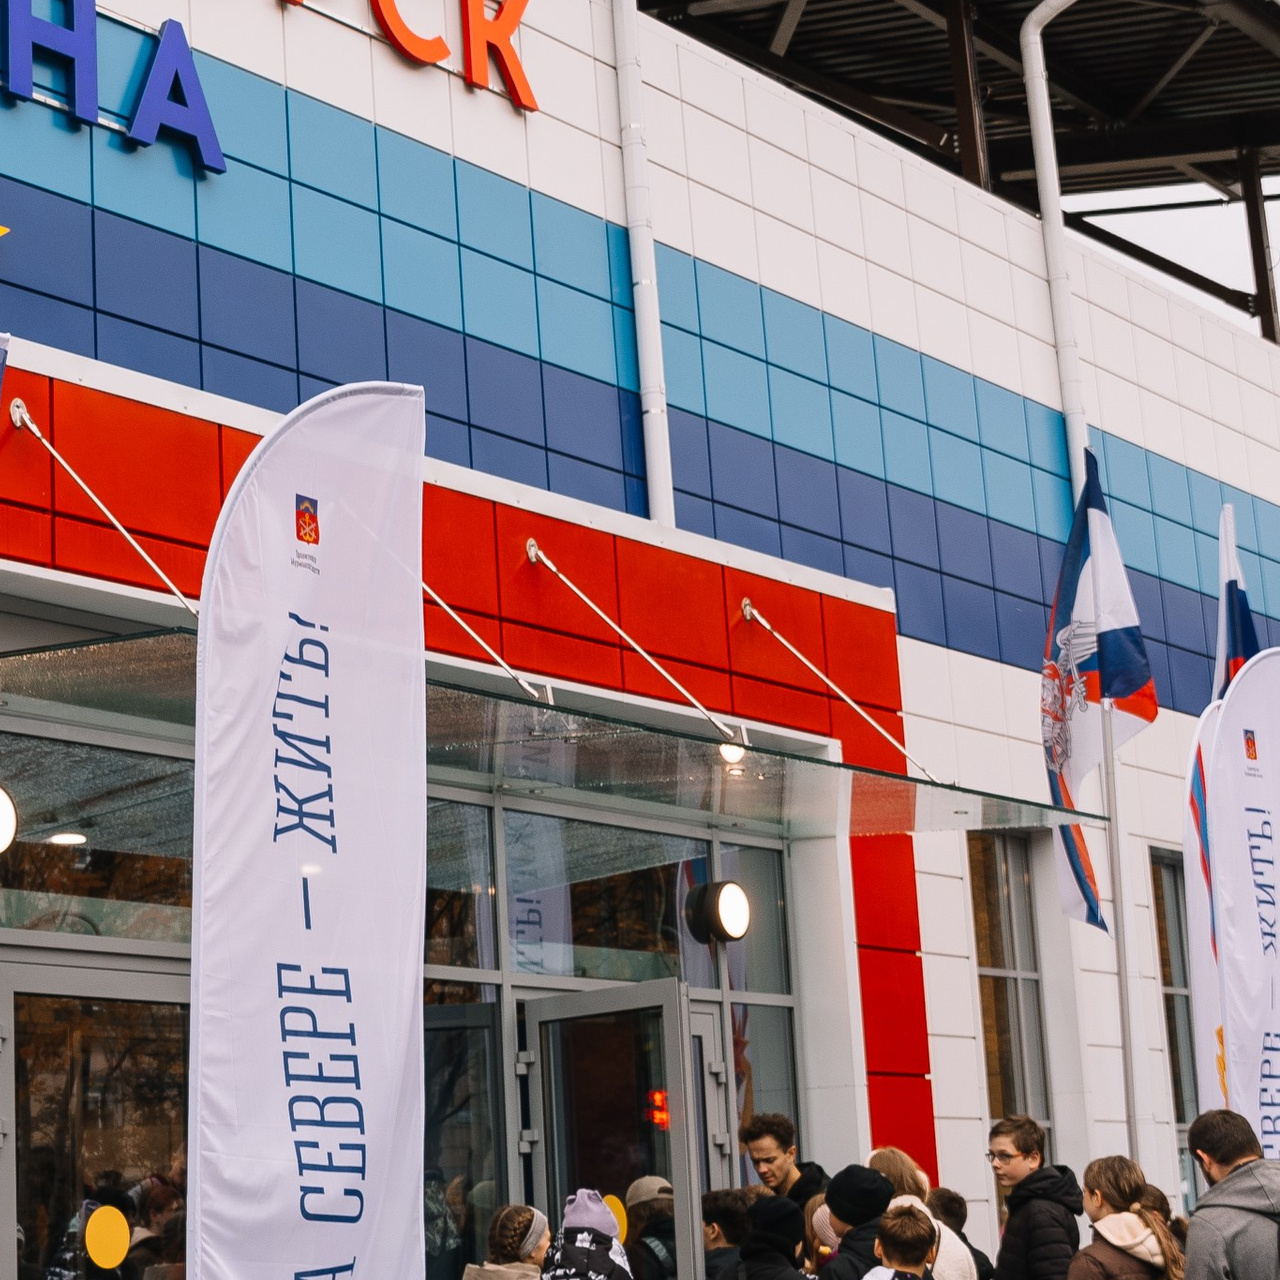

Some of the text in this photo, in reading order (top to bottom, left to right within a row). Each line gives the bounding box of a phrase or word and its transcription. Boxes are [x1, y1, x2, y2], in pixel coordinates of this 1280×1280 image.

[272, 611, 338, 854] ЖИТЬ!
[1244, 807, 1278, 960] ЖИТЬ!
[276, 962, 367, 1224] СЕВЕРЕ
